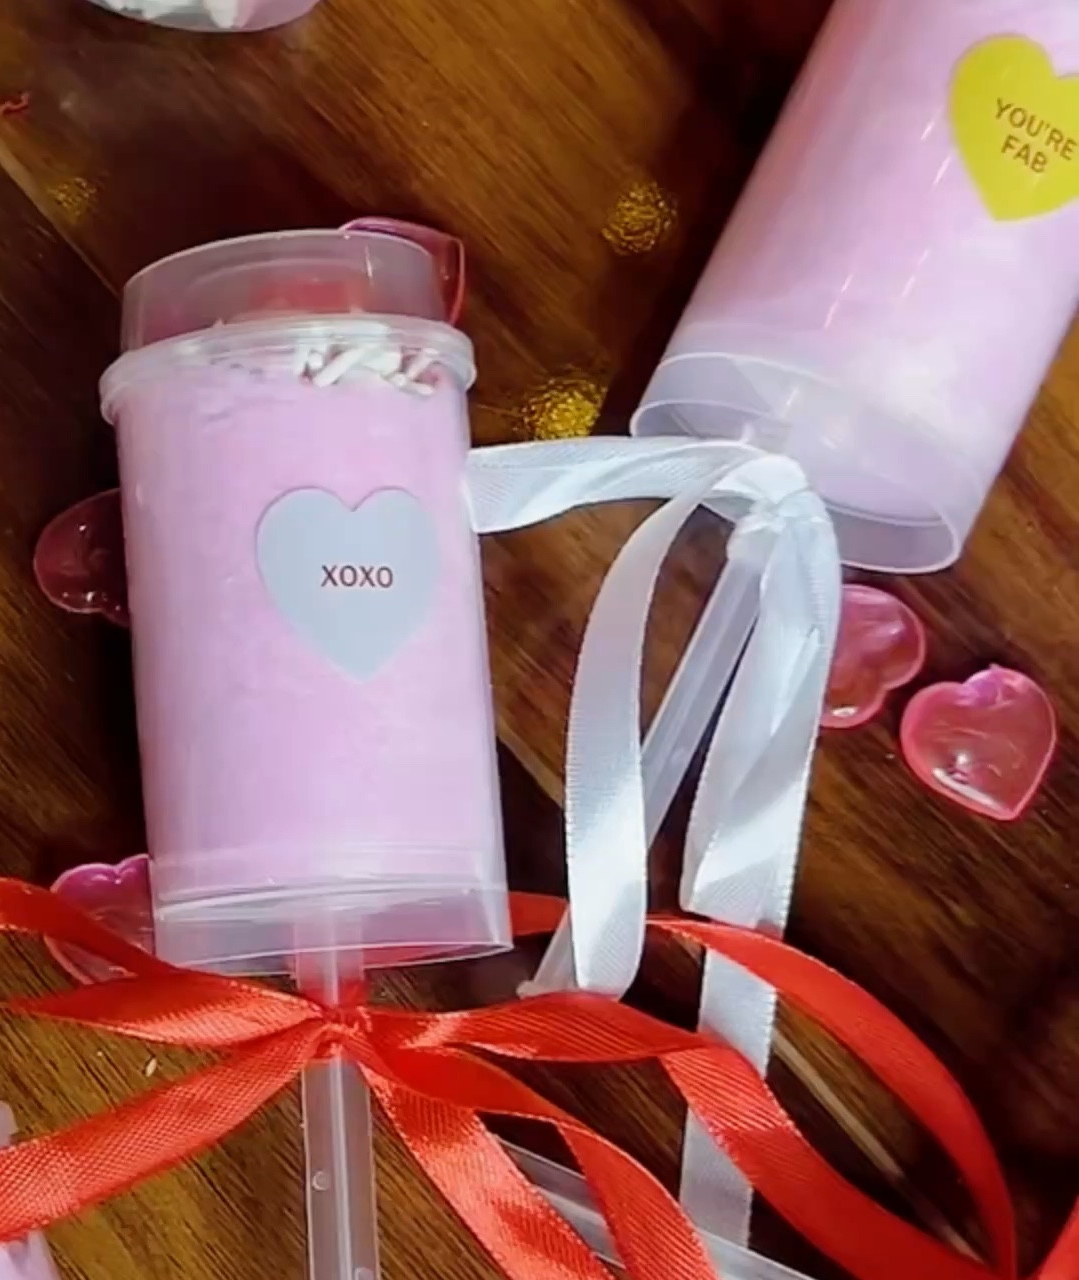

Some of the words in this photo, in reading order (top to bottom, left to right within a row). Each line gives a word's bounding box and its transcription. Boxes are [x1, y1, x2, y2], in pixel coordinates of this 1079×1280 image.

[994, 97, 1078, 162] YOU'RE
[1000, 134, 1049, 174] FAB
[320, 564, 395, 589] XOXO
